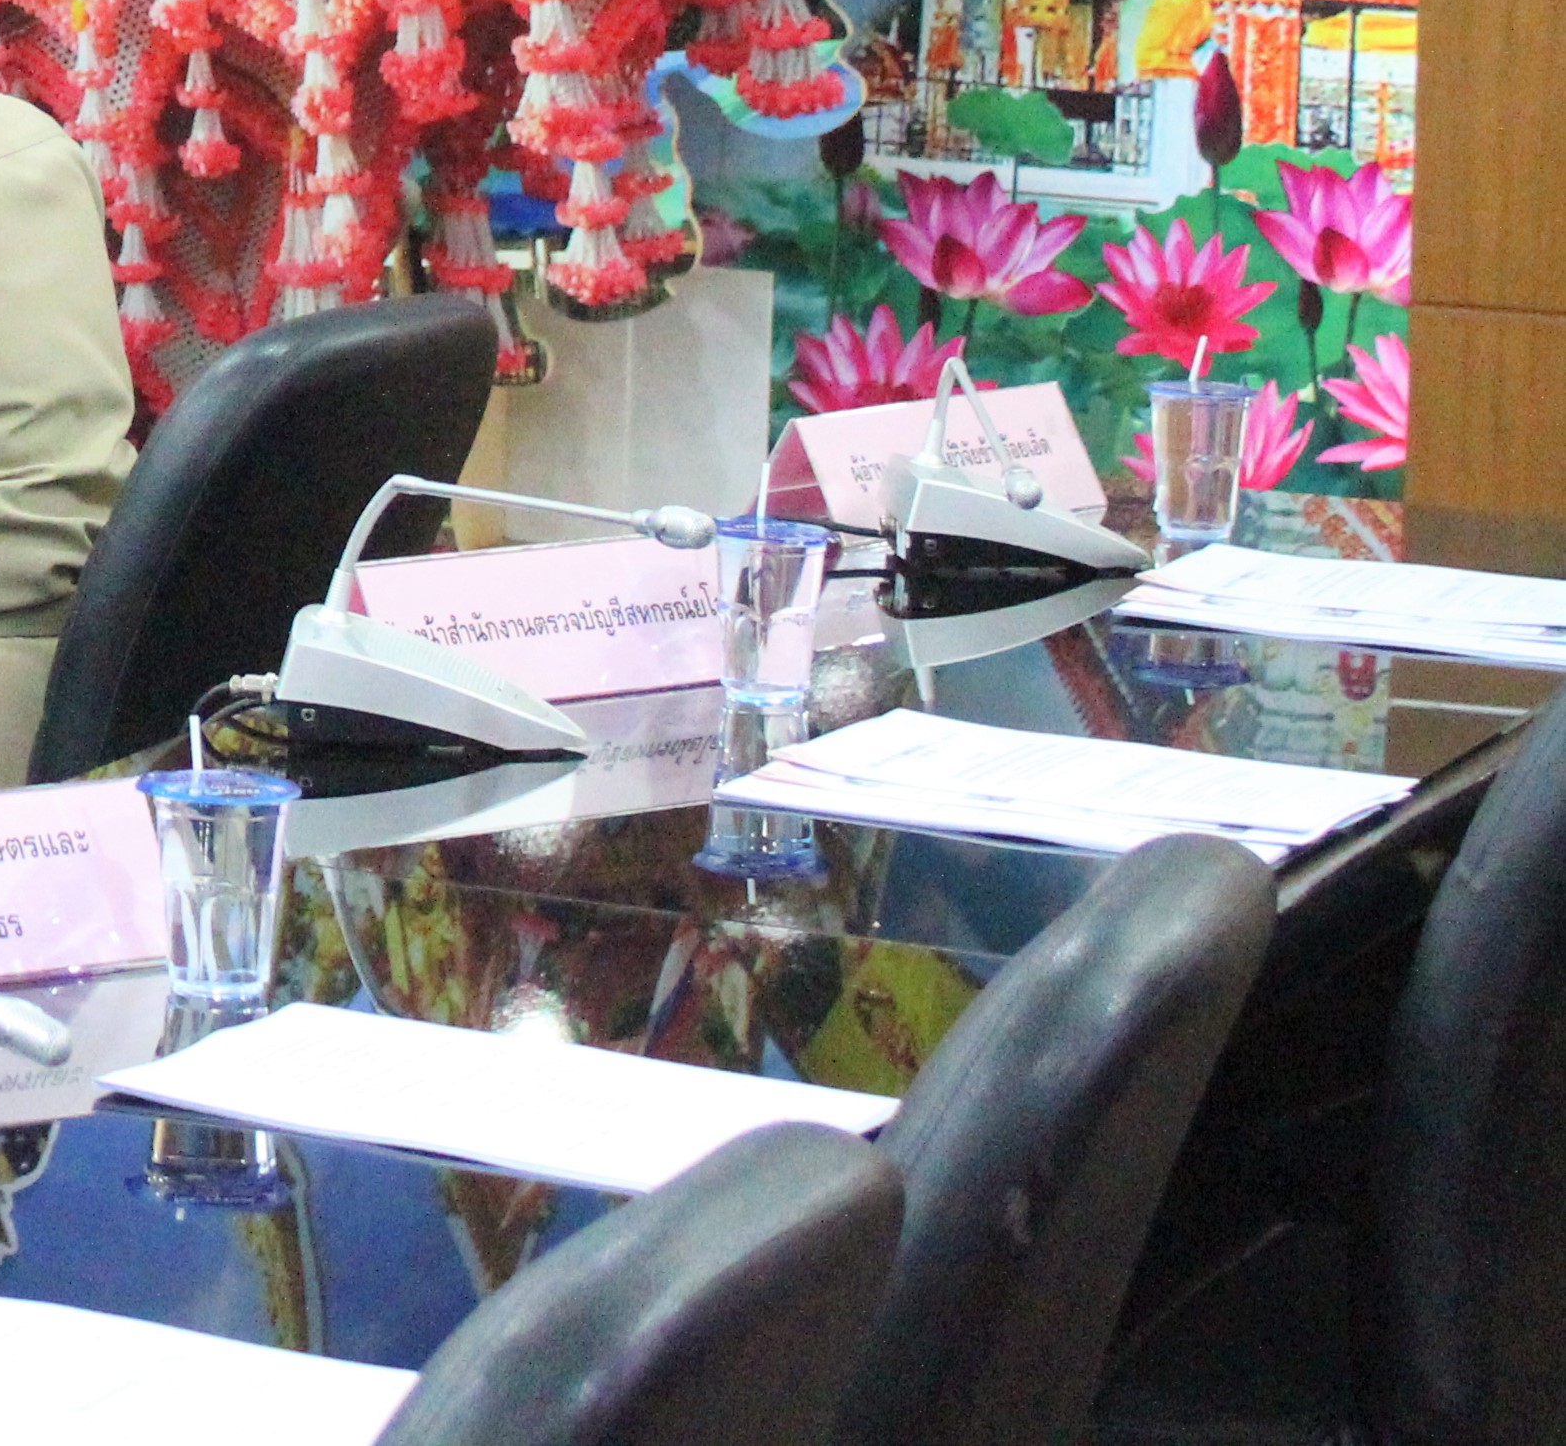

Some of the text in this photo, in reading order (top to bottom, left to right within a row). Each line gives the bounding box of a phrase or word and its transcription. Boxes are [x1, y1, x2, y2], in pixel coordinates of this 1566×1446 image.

[406, 583, 719, 645] น้าสำนักงานตรวจบัญชีสหกรณ์ยโ
